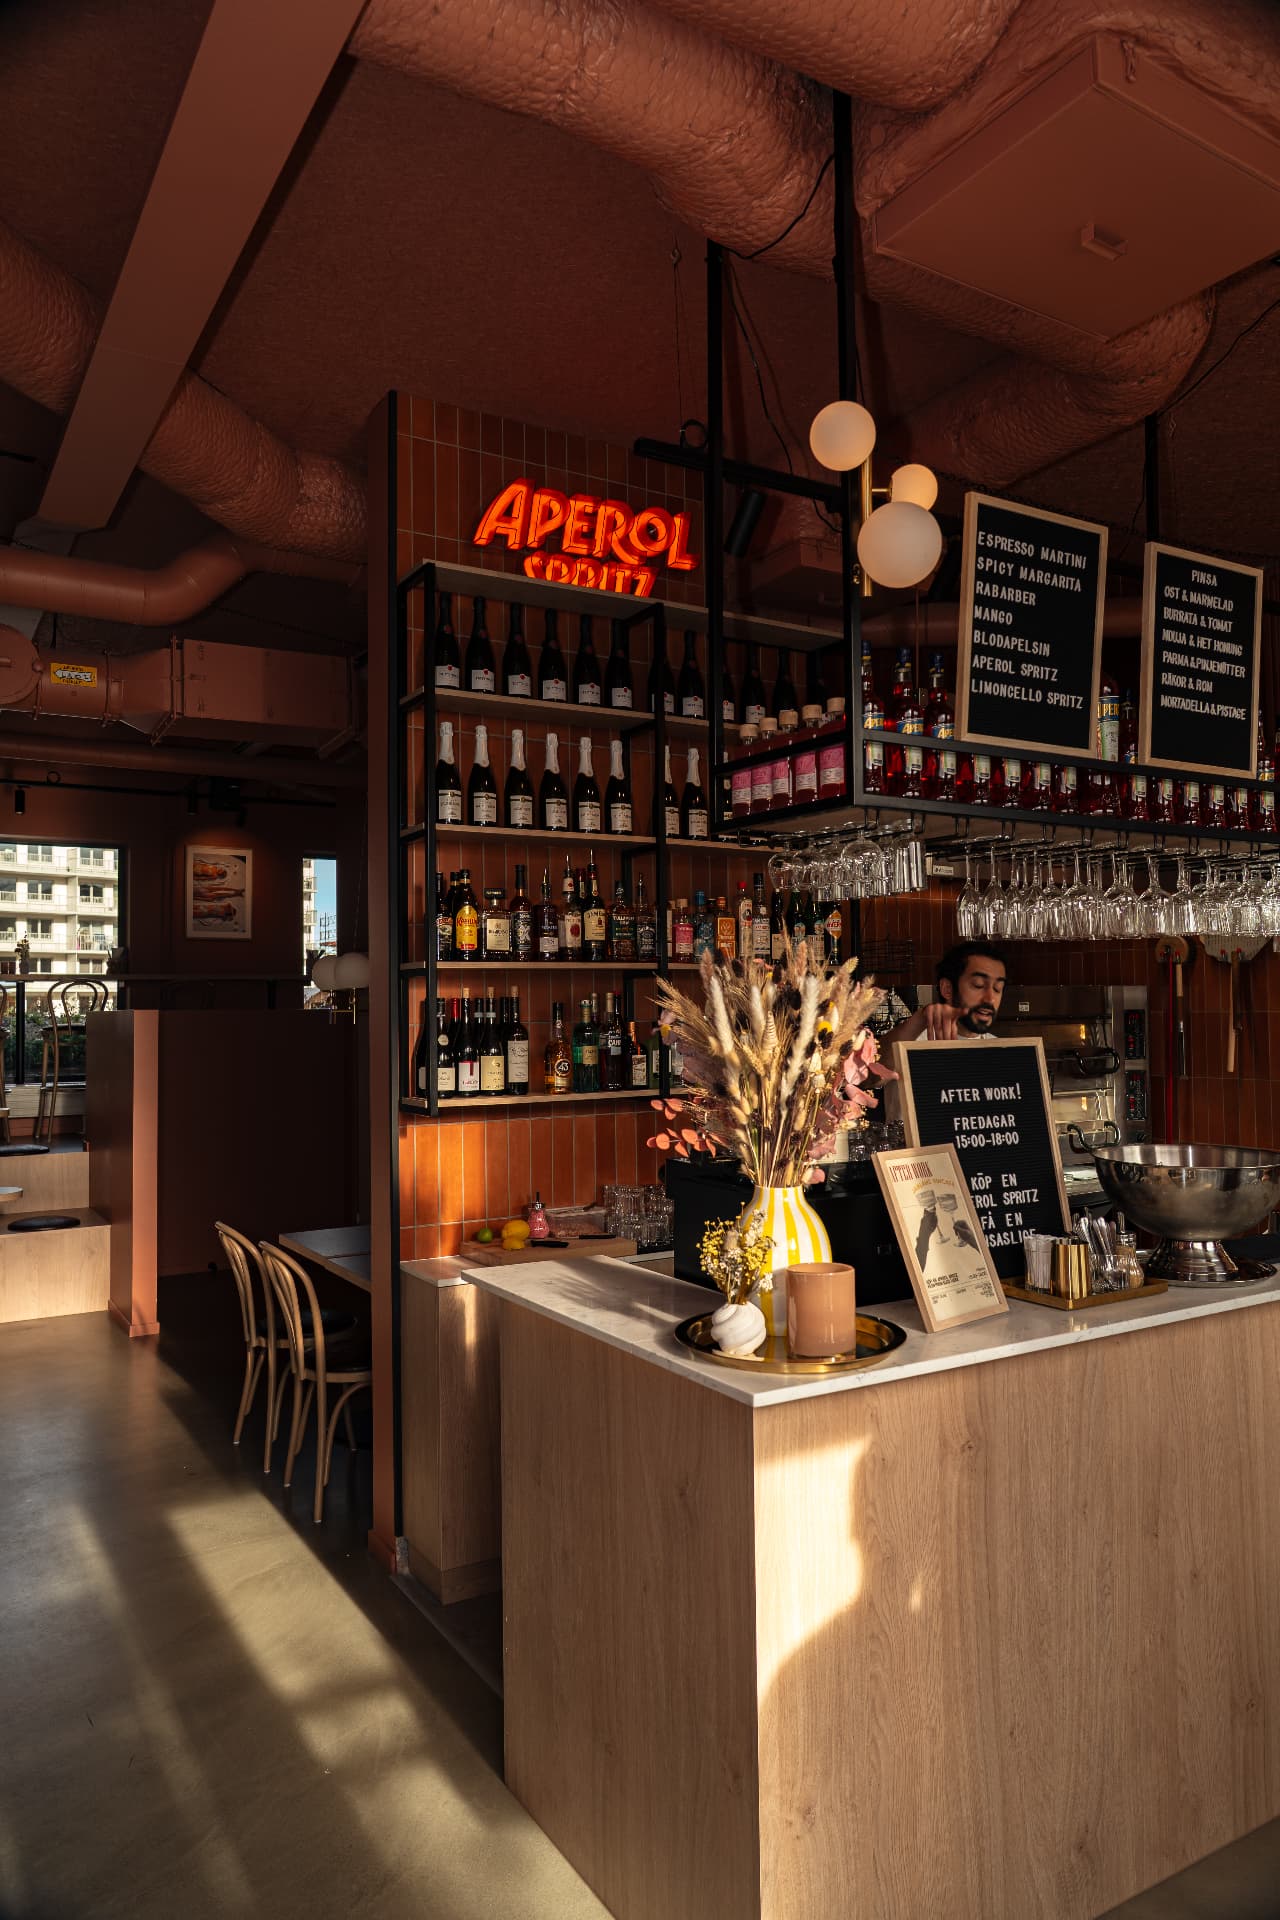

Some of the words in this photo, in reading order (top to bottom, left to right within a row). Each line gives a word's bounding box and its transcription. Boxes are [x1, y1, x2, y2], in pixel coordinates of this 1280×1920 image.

[473, 477, 698, 571] APEROL
[978, 531, 1034, 557] ESPRESSO
[1041, 546, 1086, 569] MARTINI
[977, 557, 1014, 576] SPICY
[1020, 566, 1081, 592] MARGARITA
[1192, 570, 1217, 586] PINSA
[976, 581, 1036, 606] RABARBER
[1164, 586, 1180, 599] OST
[1182, 590, 1188, 601] &
[1190, 591, 1233, 612] MARMELAD
[974, 605, 1012, 625] MANGO
[1164, 607, 1197, 626] BURRATA
[1200, 616, 1206, 627] &
[1208, 617, 1232, 633] TOMAT
[974, 630, 1050, 656] BLODAPELSIN
[1189, 636, 1195, 647] &
[1197, 636, 1212, 650] HET
[1214, 640, 1242, 656] HONUNG
[972, 655, 1014, 674] APEROL
[1021, 663, 1058, 682] SPRITZ
[971, 679, 1042, 702] LIMONCELLO
[1047, 692, 1083, 709] SPRITZ
[1188, 678, 1194, 689] &
[940, 1088, 980, 1104] AFTER
[984, 1082, 1022, 1101] WORK!
[954, 1114, 1016, 1131] FREDAGAR
[956, 1132, 1019, 1149] 15:00-18:00
[1002, 1173, 1018, 1188] EN
[1002, 1189, 1039, 1206] SPRITZ
[981, 1212, 996, 1230] FÅ
[1006, 1212, 1022, 1227] EN
